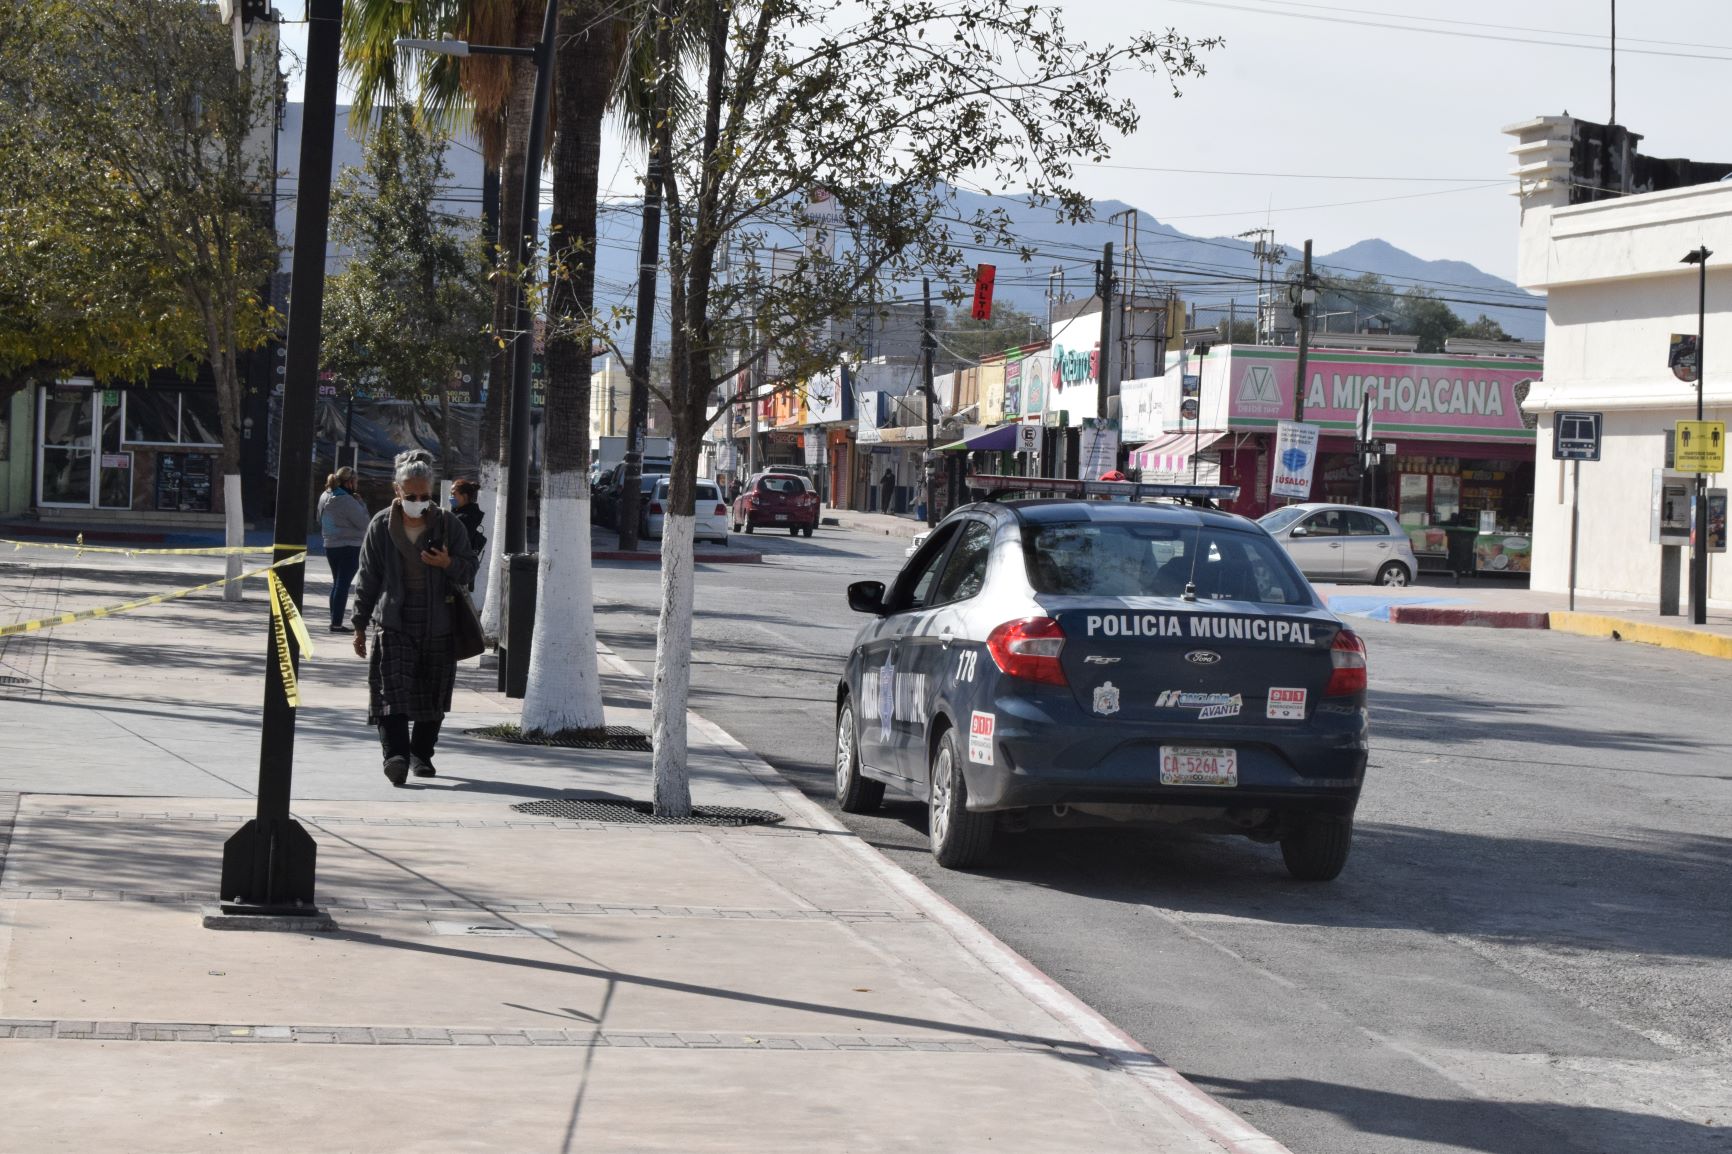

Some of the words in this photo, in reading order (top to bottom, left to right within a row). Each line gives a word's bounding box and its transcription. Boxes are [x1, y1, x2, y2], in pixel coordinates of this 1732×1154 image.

[803, 213, 845, 223] ARMACIAS
[977, 283, 989, 320] ALTO
[1302, 373, 1327, 408] A
[1332, 374, 1504, 416] MICHOACANA
[1275, 474, 1309, 488] ¡ÚSALO!
[1087, 615, 1182, 637] POLICIA
[1190, 616, 1315, 645] MUNICIPAL
[955, 649, 977, 683] 178
[1084, 655, 1121, 664] Figo
[1192, 652, 1213, 663] Ford
[1271, 690, 1304, 702] 911
[1202, 704, 1239, 717] AVANTE
[972, 715, 992, 735] 911
[1163, 755, 1234, 775] CA-526A-2
